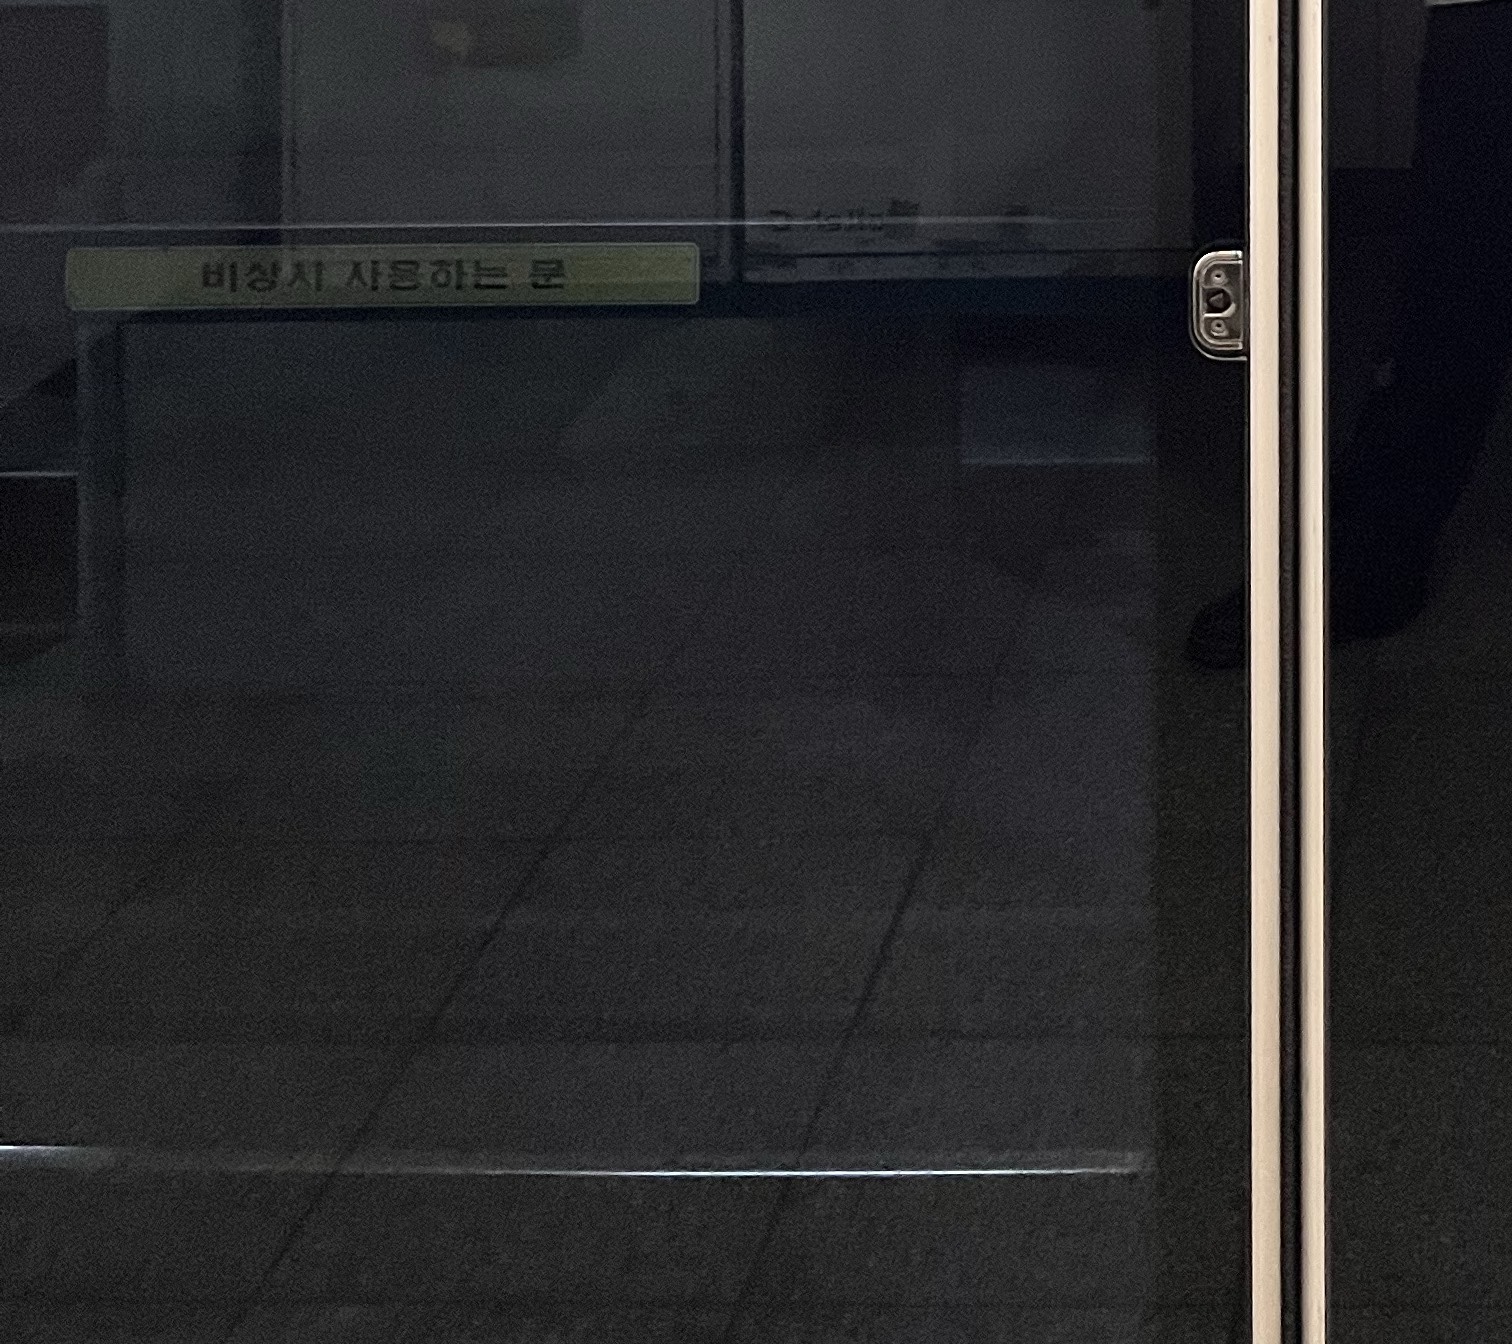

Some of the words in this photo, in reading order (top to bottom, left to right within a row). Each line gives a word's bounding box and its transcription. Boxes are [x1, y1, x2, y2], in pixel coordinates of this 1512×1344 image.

[201, 258, 323, 294] 비상시
[345, 257, 508, 292] 사용하는
[529, 256, 567, 291] 문
